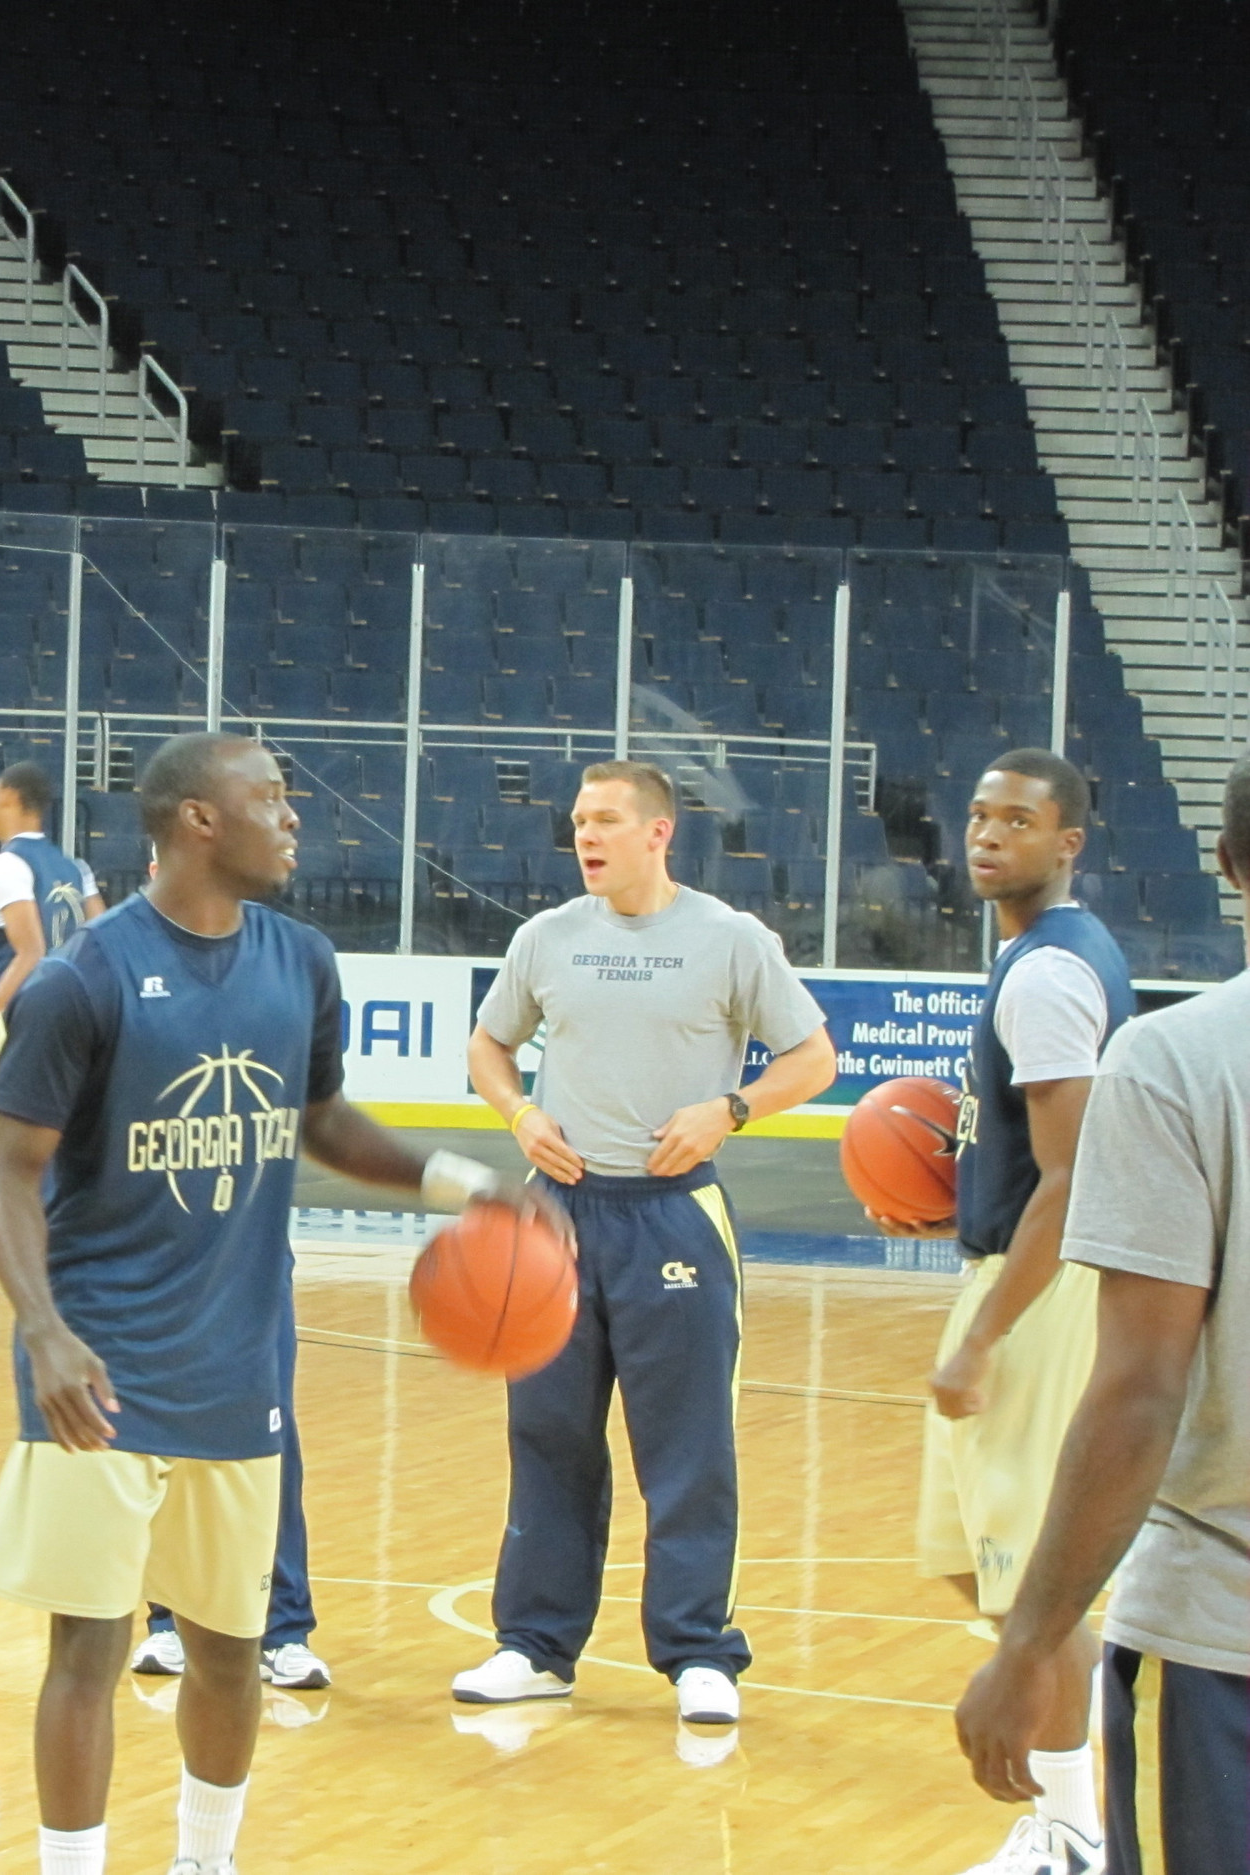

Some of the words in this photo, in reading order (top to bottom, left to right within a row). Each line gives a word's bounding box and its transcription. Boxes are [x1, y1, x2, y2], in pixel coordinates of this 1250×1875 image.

[572, 954, 637, 967] GEORGIA
[643, 956, 683, 969] TECH
[597, 968, 653, 981] TENNIS
[893, 990, 923, 1014] The
[341, 999, 434, 1058] AI
[852, 1021, 924, 1045] Medical
[927, 1025, 973, 1047] Provi
[837, 1051, 865, 1074] the
[869, 1054, 951, 1077] Gwinnett
[127, 1113, 244, 1173] GEORGIA
[212, 1174, 235, 1212] 0
